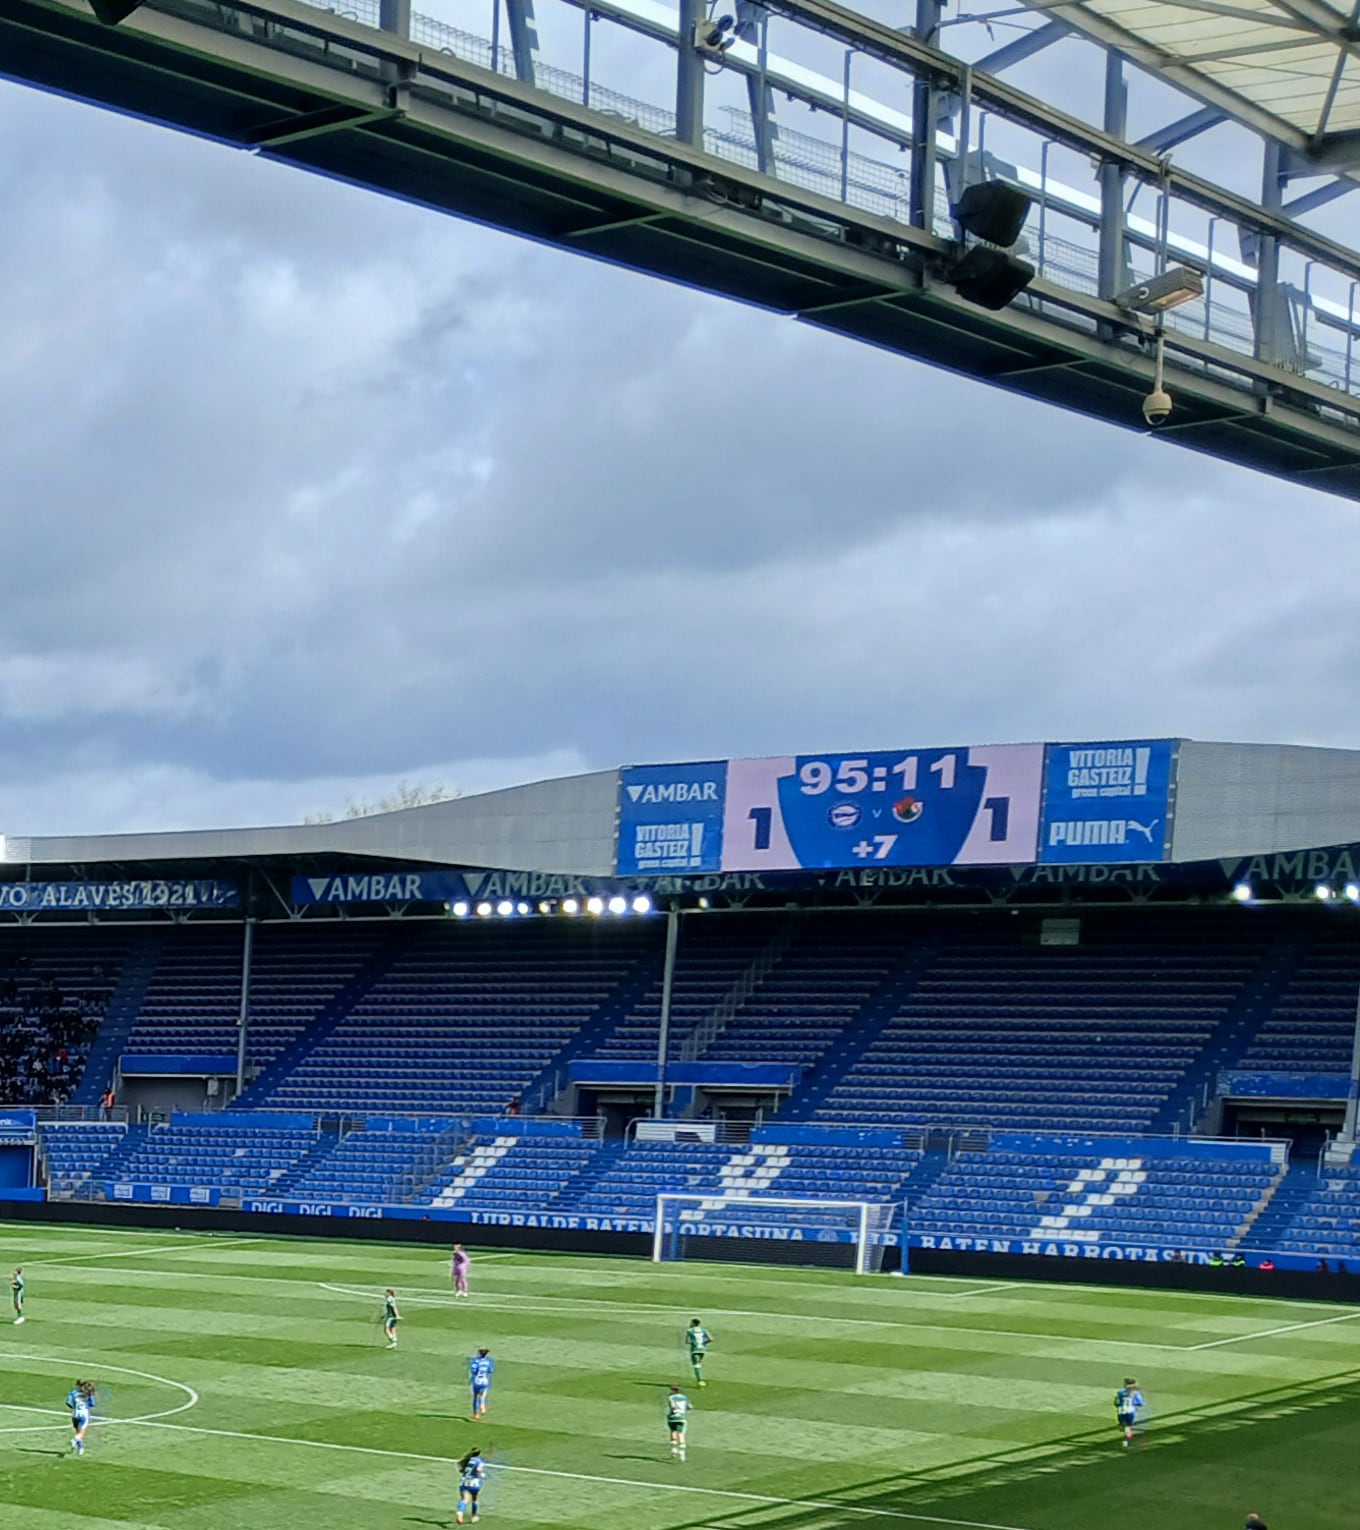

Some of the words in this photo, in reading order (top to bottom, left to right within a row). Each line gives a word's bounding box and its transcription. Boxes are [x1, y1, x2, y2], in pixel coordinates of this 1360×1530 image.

[1069, 748, 1133, 768] VITORIA
[799, 753, 956, 797] 95:11
[641, 781, 719, 803] AMBAR
[747, 806, 772, 850] 1
[983, 796, 1010, 842] 1
[635, 823, 690, 842] VITORIA
[1049, 820, 1127, 846] PUMA
[852, 834, 898, 860] +7
[1246, 850, 1360, 881] AMBA
[329, 875, 423, 901] AMBAR
